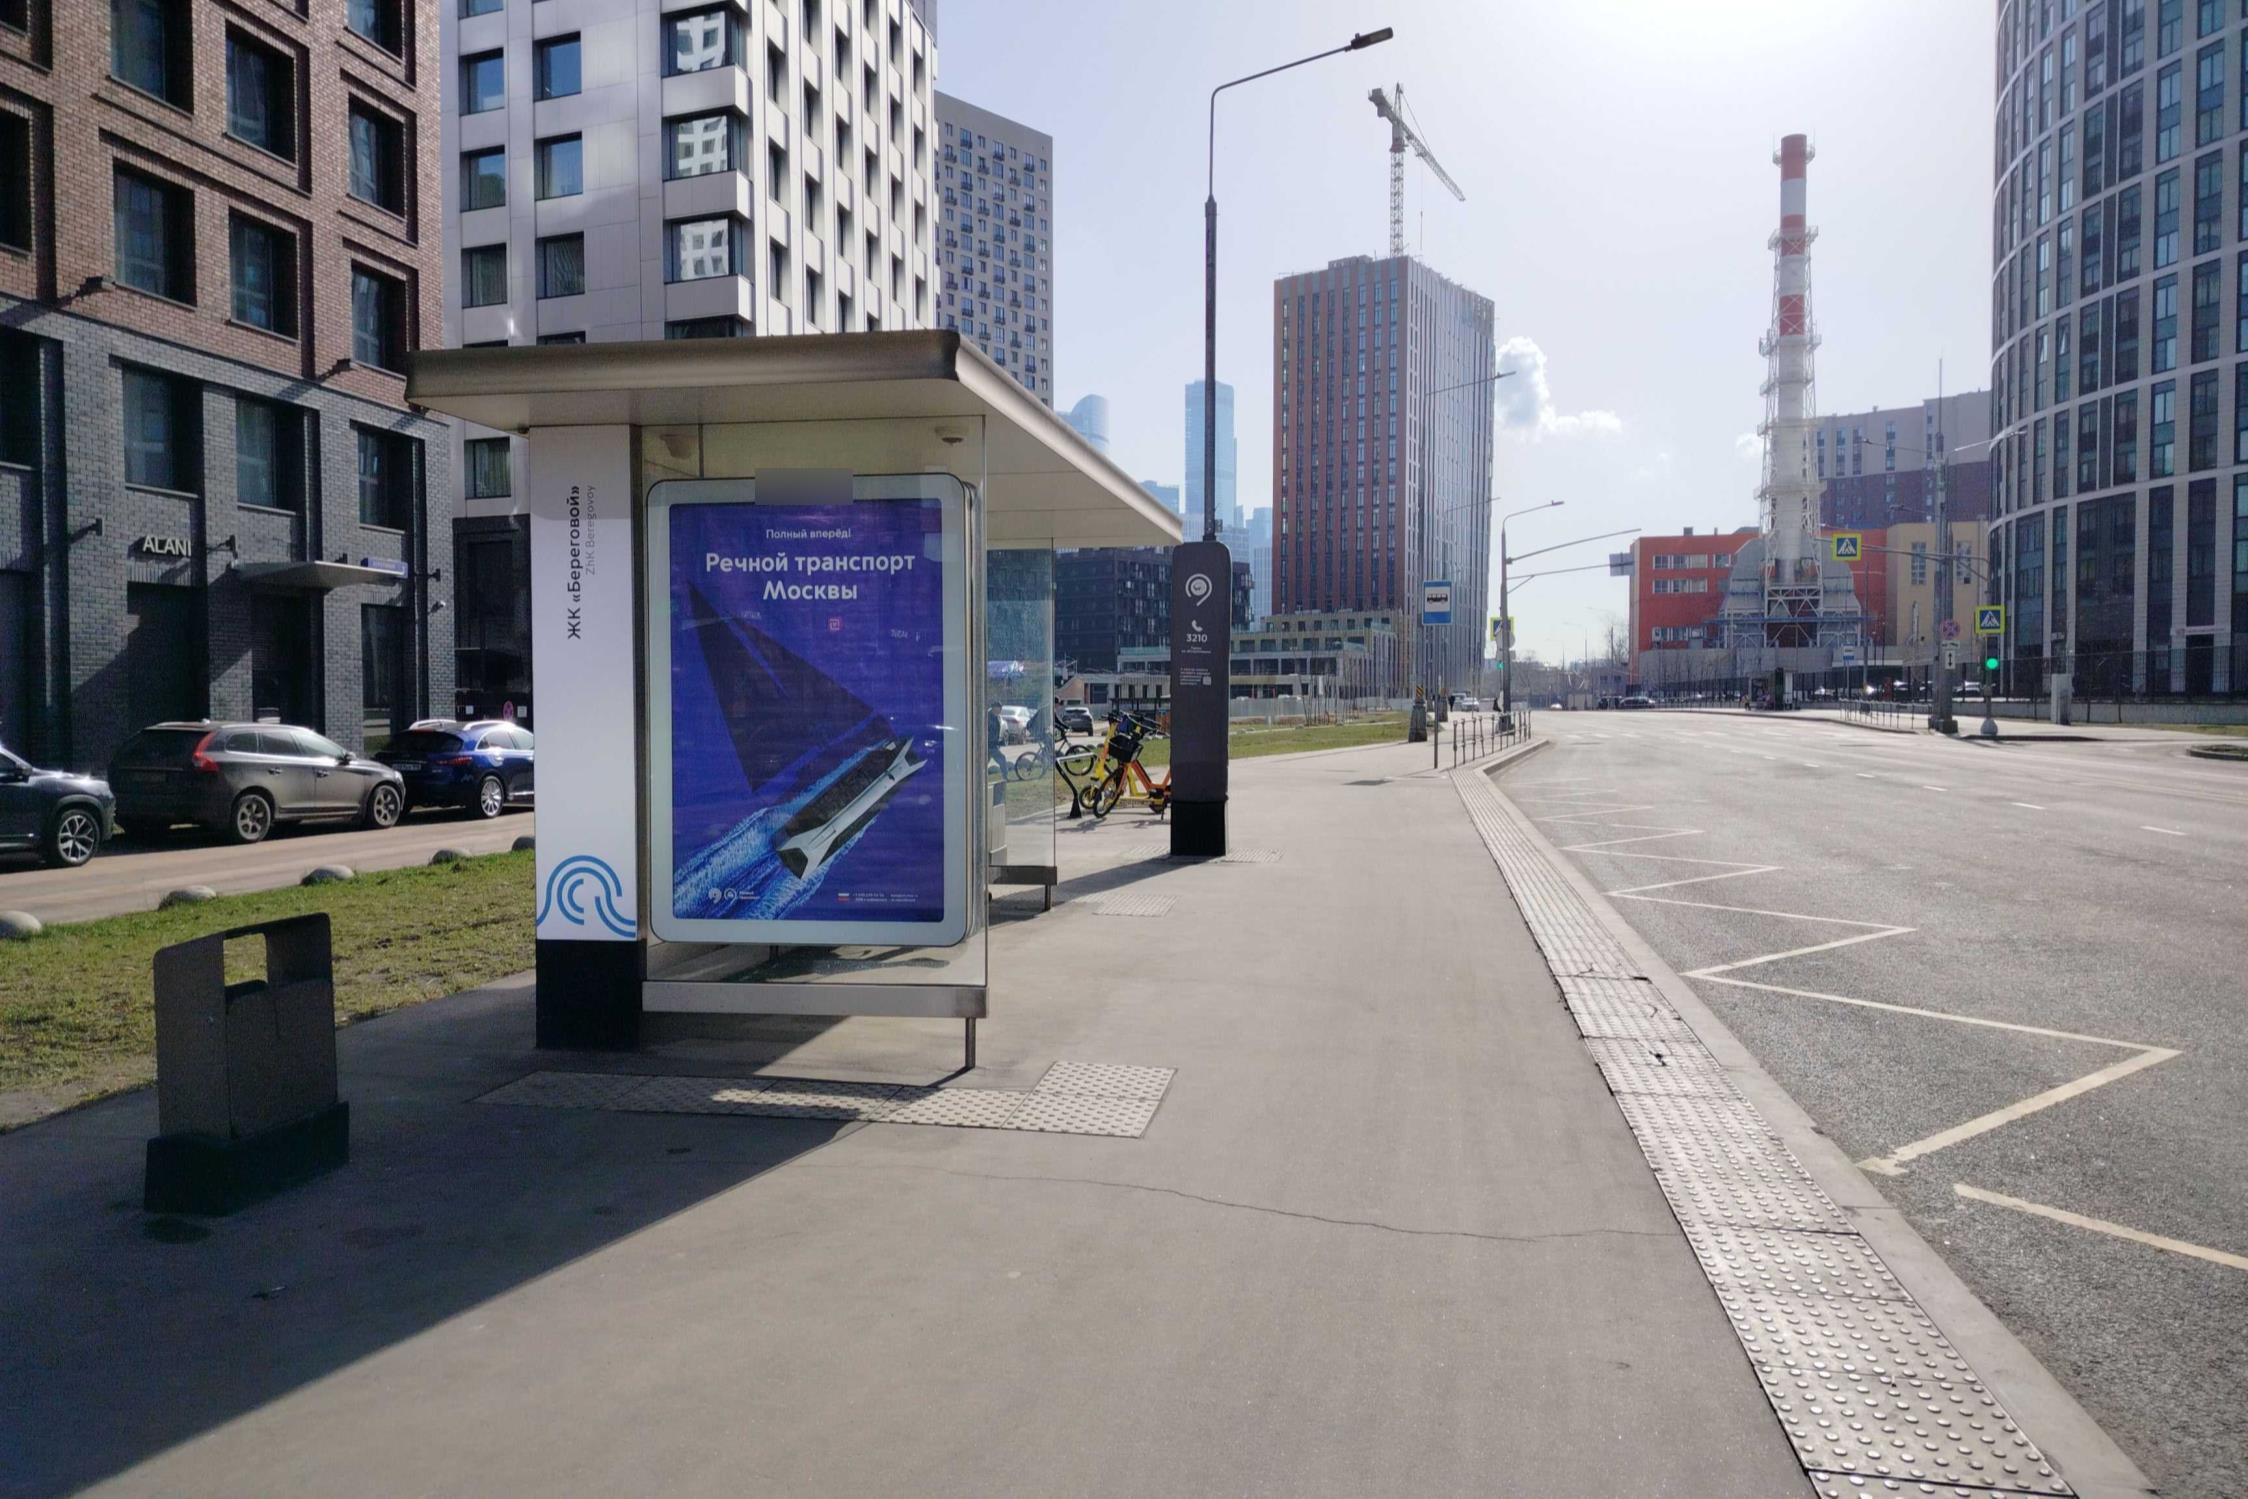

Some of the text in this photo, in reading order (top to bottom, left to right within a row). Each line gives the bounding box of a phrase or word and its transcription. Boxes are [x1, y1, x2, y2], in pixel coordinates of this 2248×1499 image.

[585, 484, 597, 576] ZhK Beregovoy
[765, 528, 852, 539] Полный вперёд!
[142, 535, 192, 557] ALANI
[566, 485, 583, 639] ЖК «Береговой»
[705, 552, 916, 575] Речной транспорт
[762, 580, 858, 600] Москвы
[1186, 633, 1208, 643] 3210
